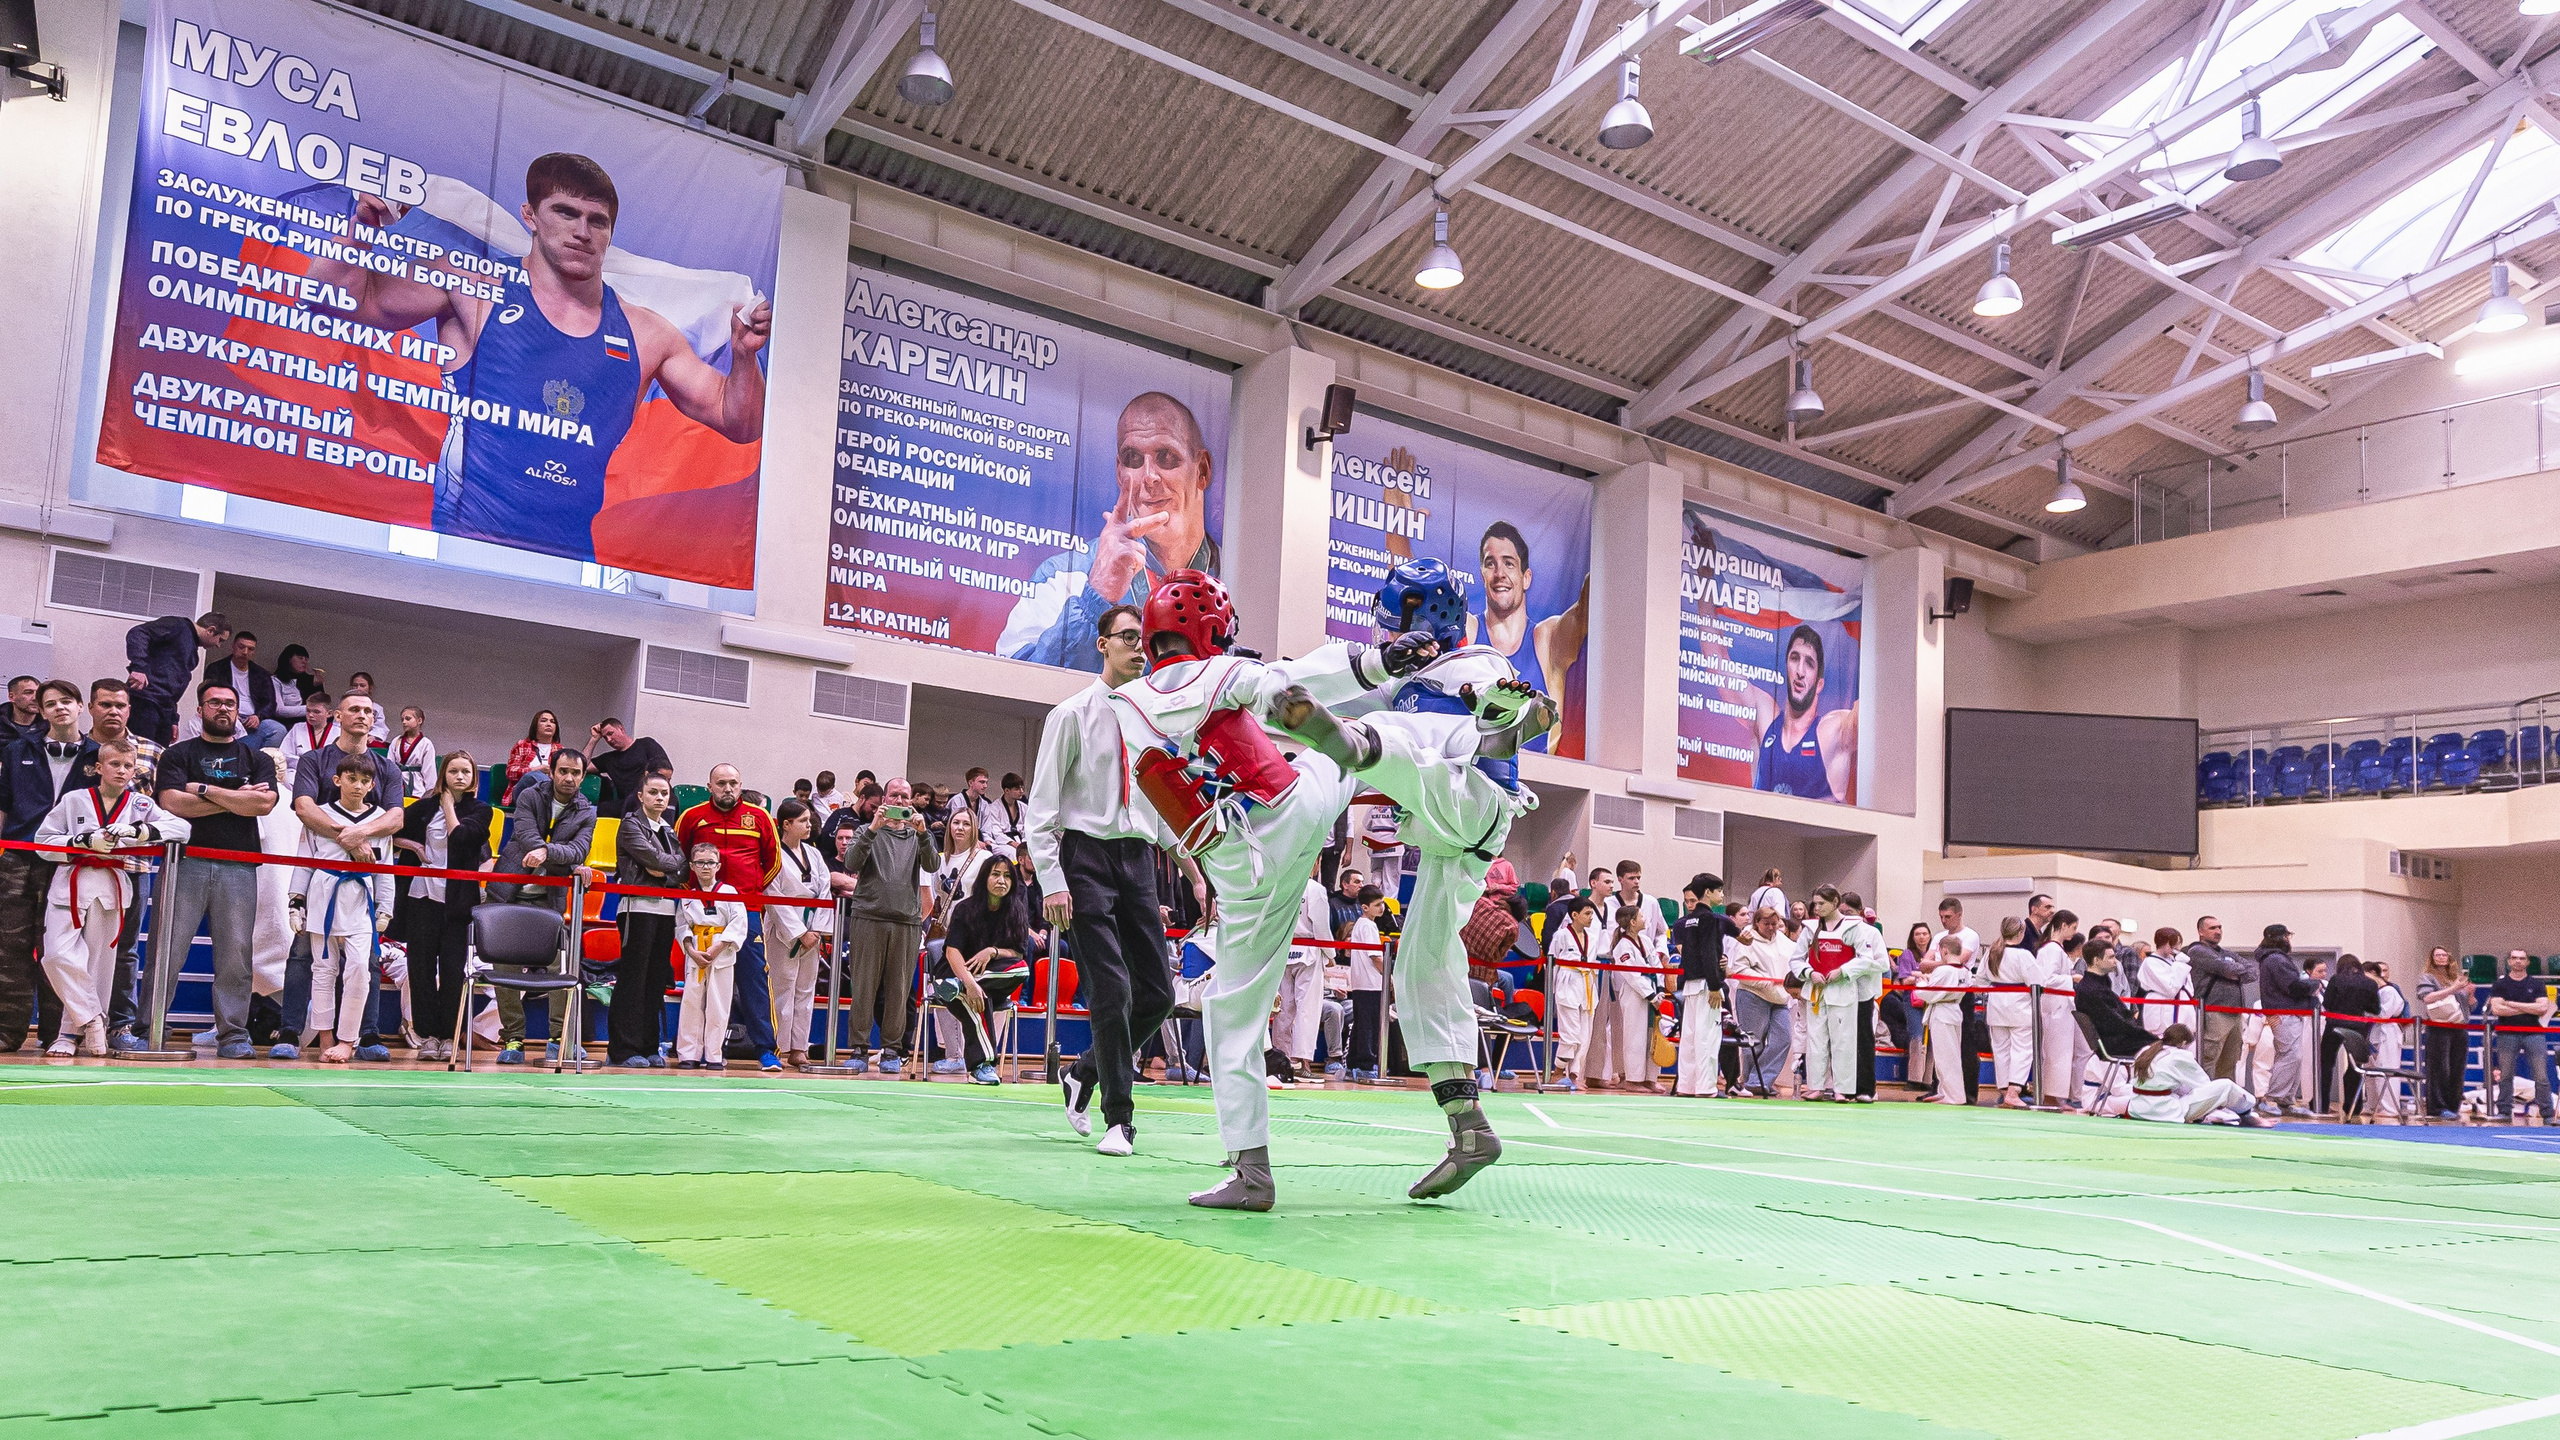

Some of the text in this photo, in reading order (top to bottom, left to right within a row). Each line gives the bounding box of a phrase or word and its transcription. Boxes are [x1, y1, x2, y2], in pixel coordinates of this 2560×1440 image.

[171, 18, 361, 122] МУСА
[163, 88, 427, 206] ЕВЛОЕВ
[155, 195, 506, 304] ПО ГРЕКО-РИМСКОЙ БОРЬБЕ
[157, 168, 531, 287] ЗАСЛУЖЕННЫЙ МАСТЕР СПОРТА
[151, 240, 358, 311] ПОБЕДИТЕЛЬ
[148, 274, 457, 367] ОЛИМПИЙСКИХ ИГР
[846, 277, 1058, 370] Александр
[139, 323, 595, 447] ДВУКРАТНЫЙ ЧЕМПИОН МИРА
[842, 324, 1027, 405] КАРЕЛИН
[132, 371, 354, 439] ДВУКРАТНЫЙ
[838, 398, 1054, 461] ПО ГРЕКО-РИМСКОЙ БОРЬБЕ
[840, 379, 1071, 447] ЗАСЛУЖЕННЫЙ МАСТЕР СПОРТА
[134, 400, 436, 484] ЧЕМПИОН ЕВРОПЫ
[837, 428, 1032, 488] ГЕРОЙ РОССИЙСКОЙ
[524, 465, 577, 487] ALROSA
[836, 451, 955, 491] ФЕДЕРАЦИИ
[1332, 451, 1431, 499] лексей
[834, 508, 1019, 560] ОЛИМПИЙСКИХ ИГР
[835, 484, 1090, 554] ТРЁХКРАТНЫЙ ПОБЕДИТЕЛЬ
[830, 566, 887, 592] МИРА
[831, 544, 1036, 599] 9-КРАТНЫЙ ЧЕМПИОН
[1328, 540, 1391, 564] ЛУЖЕННЫЙ
[1450, 569, 1475, 585] ОРТА
[1328, 556, 1389, 580] ГРЕКО-РИМ
[1681, 541, 1784, 592] дулрашид
[1326, 603, 1376, 628] ИМПИЙ
[1327, 583, 1376, 607] БЕДИТ
[1681, 571, 1760, 615] ДУЛАЕВ
[829, 602, 950, 640] 12-КРАТНЫЙ
[1701, 631, 1734, 648] БОРЬБЕ
[1712, 619, 1744, 634] МАСТЕР
[1744, 627, 1774, 643] СПОРТА
[1721, 659, 1785, 685] ПОБЕДИТЕЛЬ
[1728, 677, 1748, 692] ИГР
[1706, 698, 1757, 721] ЧЕМПИОН
[1704, 741, 1754, 763] ЧЕМПИОН
